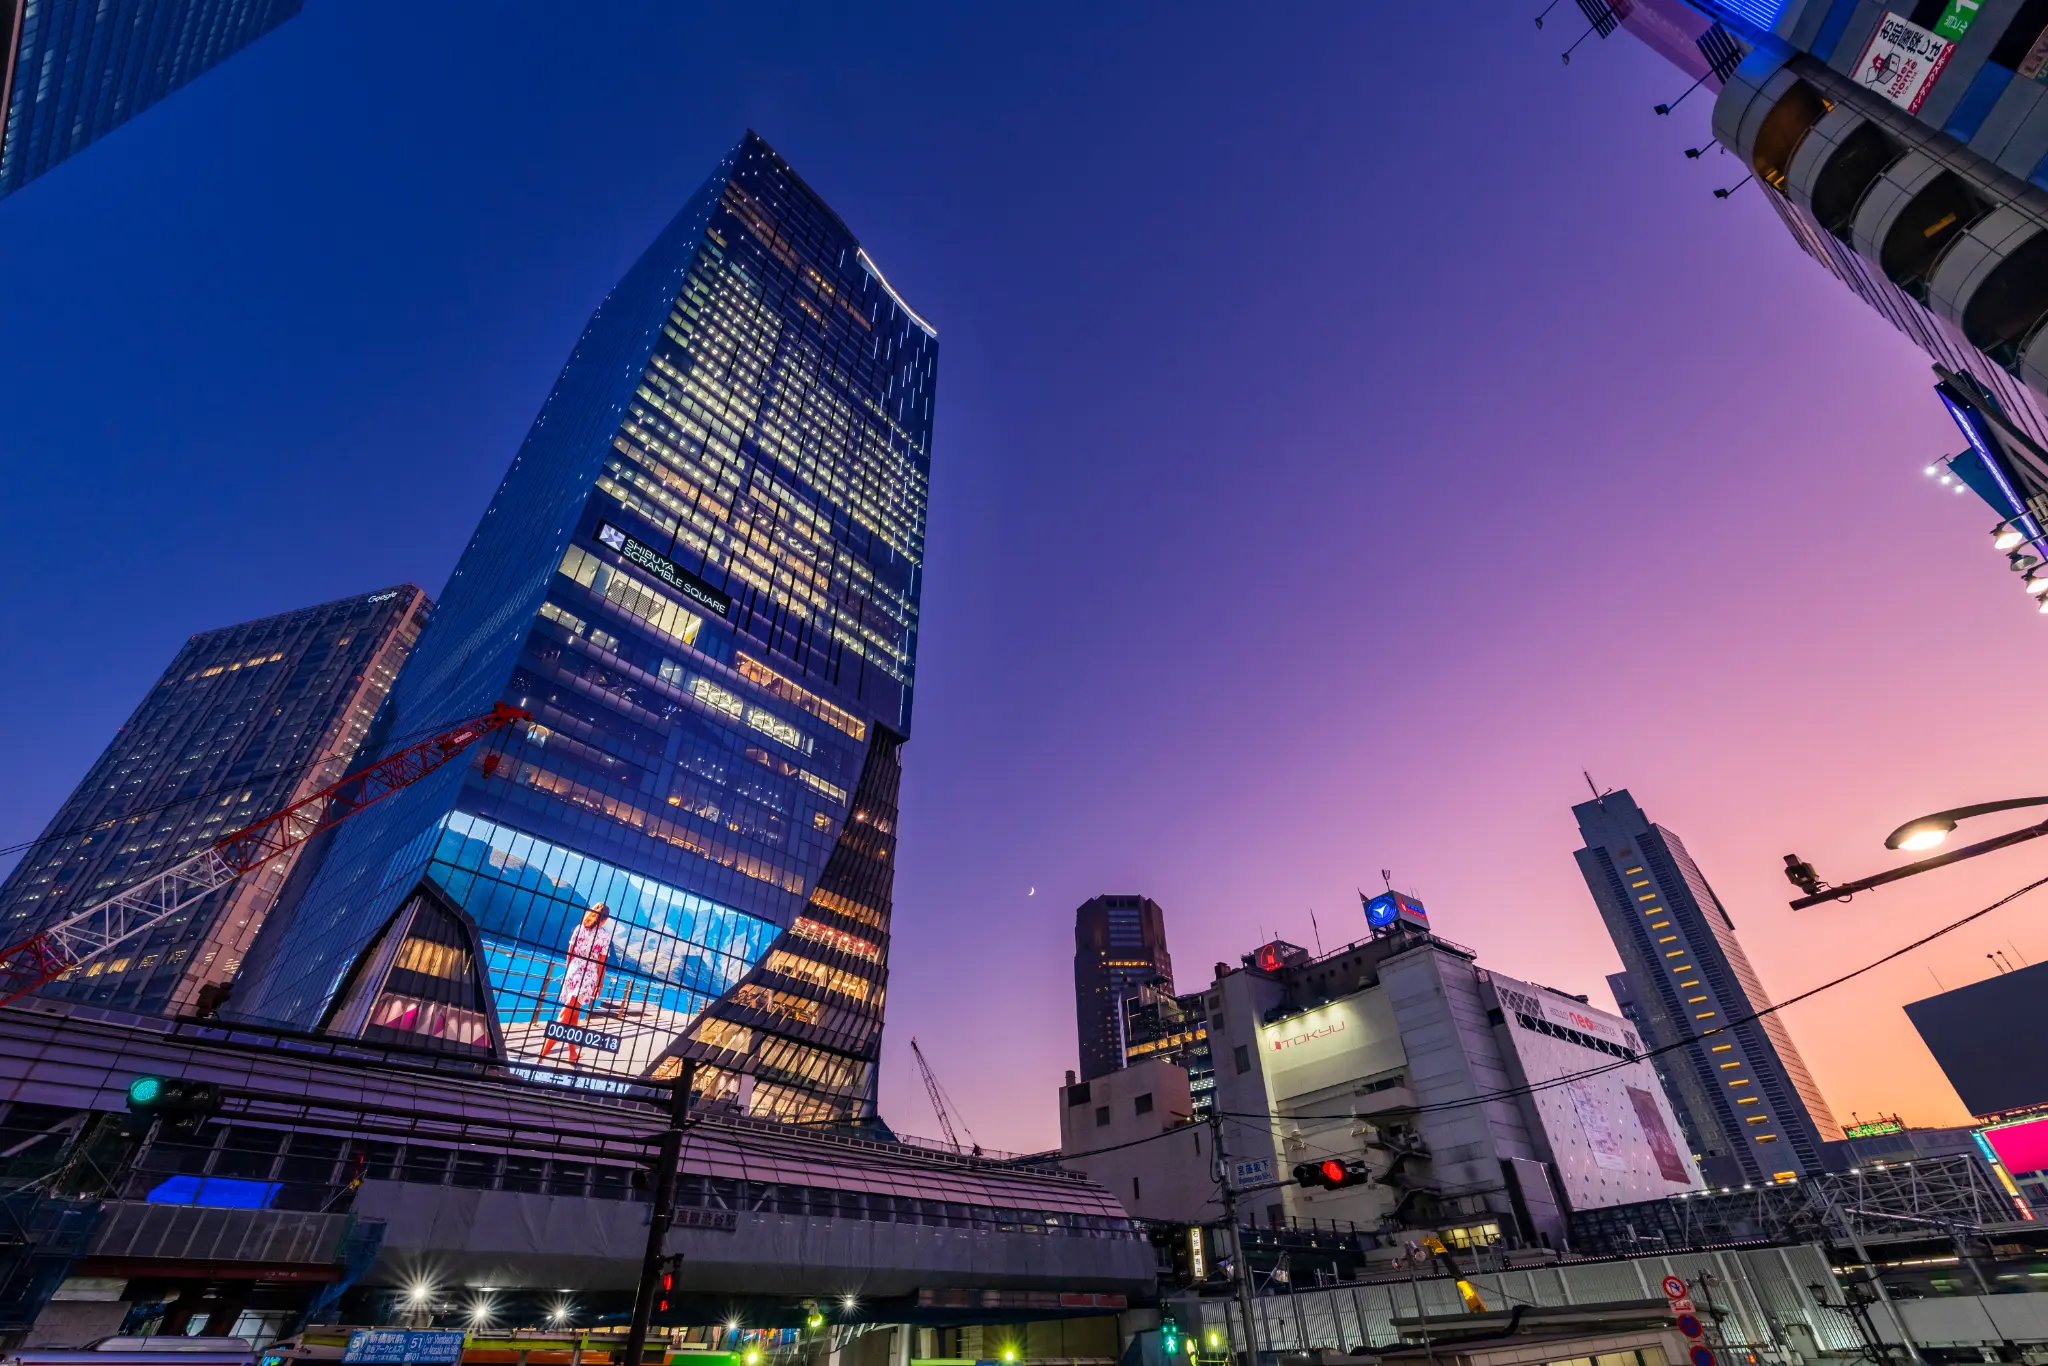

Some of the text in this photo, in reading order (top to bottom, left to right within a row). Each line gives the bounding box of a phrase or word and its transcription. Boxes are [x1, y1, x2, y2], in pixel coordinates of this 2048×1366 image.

[1880, 19, 1942, 62] お部屋探しは
[1893, 61, 1917, 98] home
[627, 539, 675, 574] SHIBUYA
[623, 547, 726, 614] SCRAMBLE SQUARE
[367, 591, 398, 603] Google
[548, 1023, 583, 1042] 00:00
[1281, 1021, 1345, 1048] TOKYU
[351, 1335, 366, 1349] 51
[410, 1337, 424, 1349] 51
